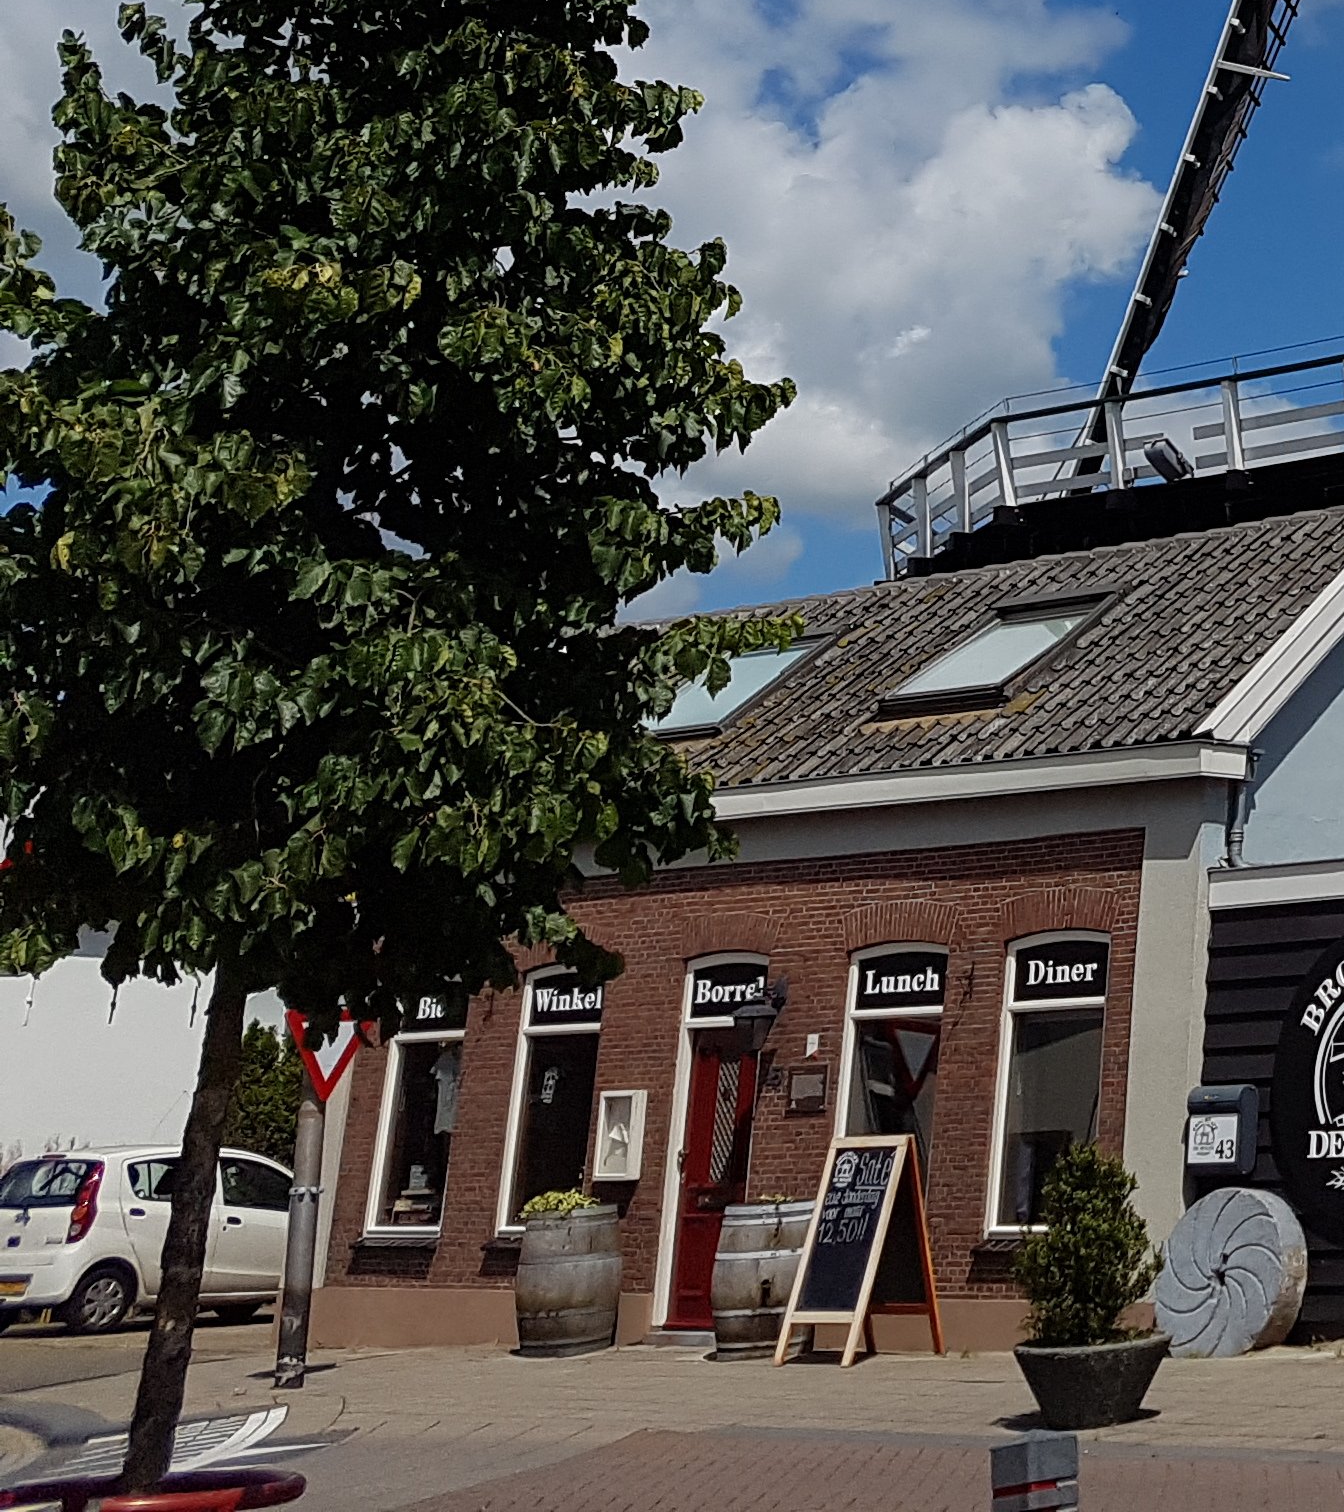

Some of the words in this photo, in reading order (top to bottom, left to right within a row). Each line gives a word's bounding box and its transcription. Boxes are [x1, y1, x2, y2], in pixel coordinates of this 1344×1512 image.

[863, 966, 940, 996] Lunch
[1025, 959, 1098, 986] Diner
[535, 985, 602, 1013] Winkel
[694, 975, 765, 1004] Borrel
[1215, 1139, 1234, 1159] 43
